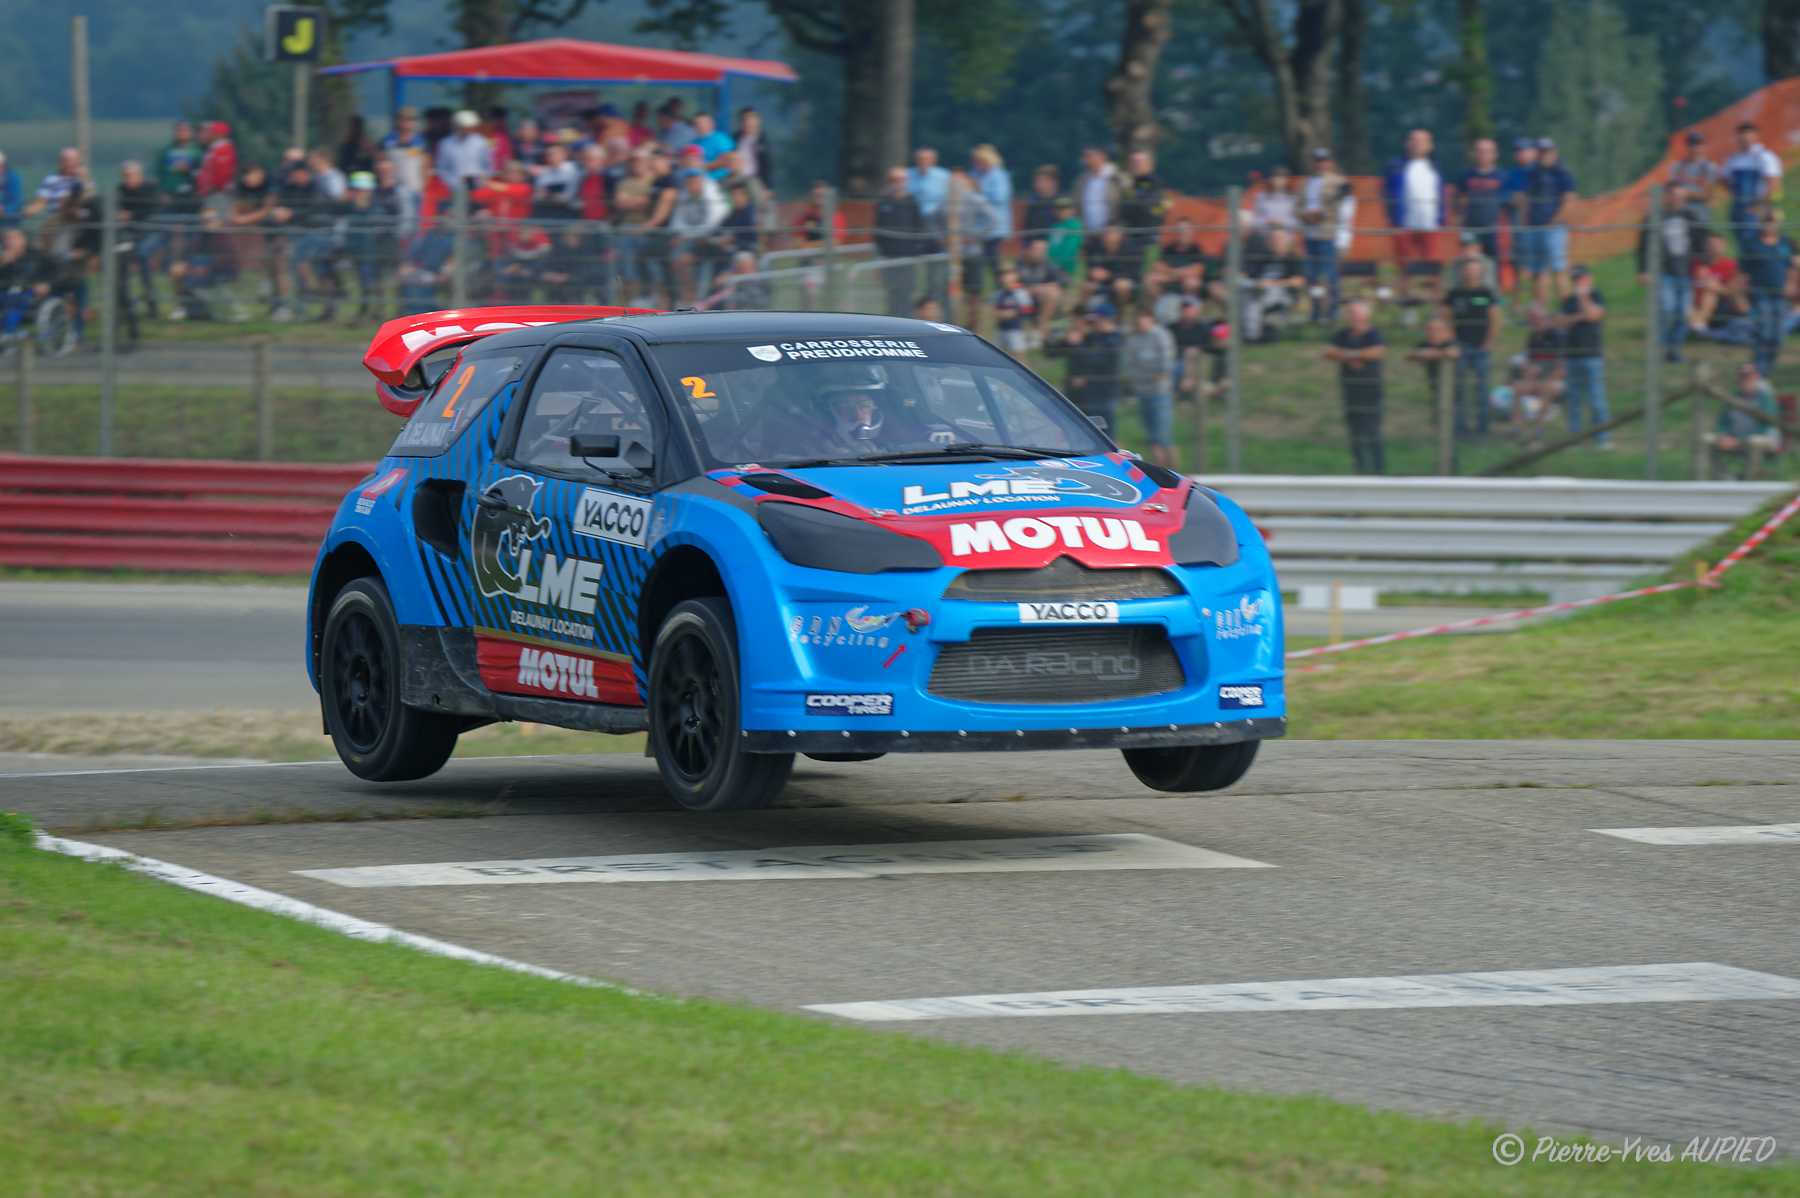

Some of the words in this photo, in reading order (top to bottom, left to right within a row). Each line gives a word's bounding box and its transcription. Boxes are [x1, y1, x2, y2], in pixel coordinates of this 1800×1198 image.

[283, 17, 315, 55] J
[780, 339, 919, 351] CARROSSERIE
[786, 348, 928, 360] PREUDHOMME
[441, 364, 476, 418] 2
[680, 376, 716, 398] 2
[903, 479, 1056, 505] LME
[903, 497, 980, 514] DELAUNAY
[982, 494, 1061, 504] LOCATION
[585, 498, 645, 538] YACCO
[949, 516, 1161, 557] MOTUL
[518, 549, 604, 615] LME
[511, 609, 552, 631] DELAUNAY
[552, 617, 594, 641] LOCATION
[1029, 603, 1109, 620] YACCO
[518, 647, 600, 698] MOTUL
[806, 694, 894, 706] COOPER
